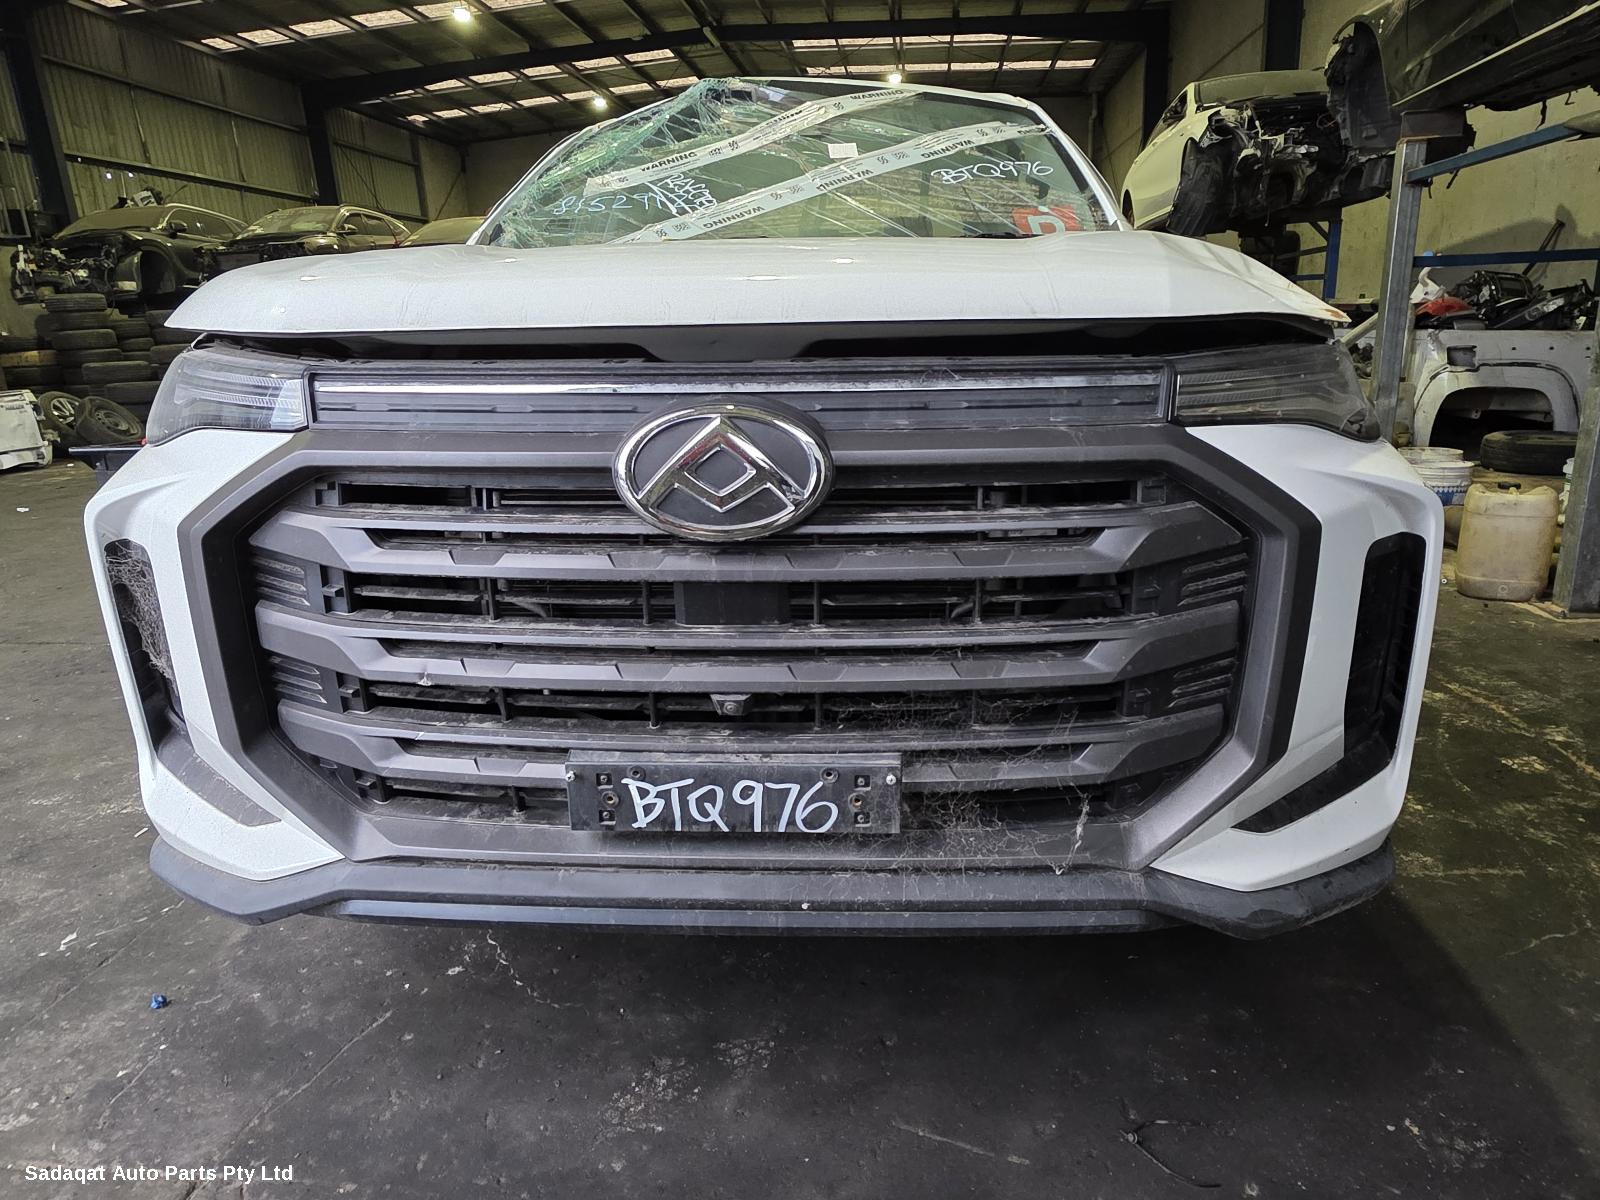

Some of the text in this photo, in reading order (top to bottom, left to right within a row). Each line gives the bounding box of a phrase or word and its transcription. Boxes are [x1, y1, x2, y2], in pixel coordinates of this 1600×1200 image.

[849, 89, 905, 101] WARNING
[920, 138, 976, 159] WARNING
[640, 151, 698, 172] WARNING
[930, 160, 1054, 184] BTQ976
[702, 205, 766, 229] WARNING
[621, 778, 839, 833] BTQ976
